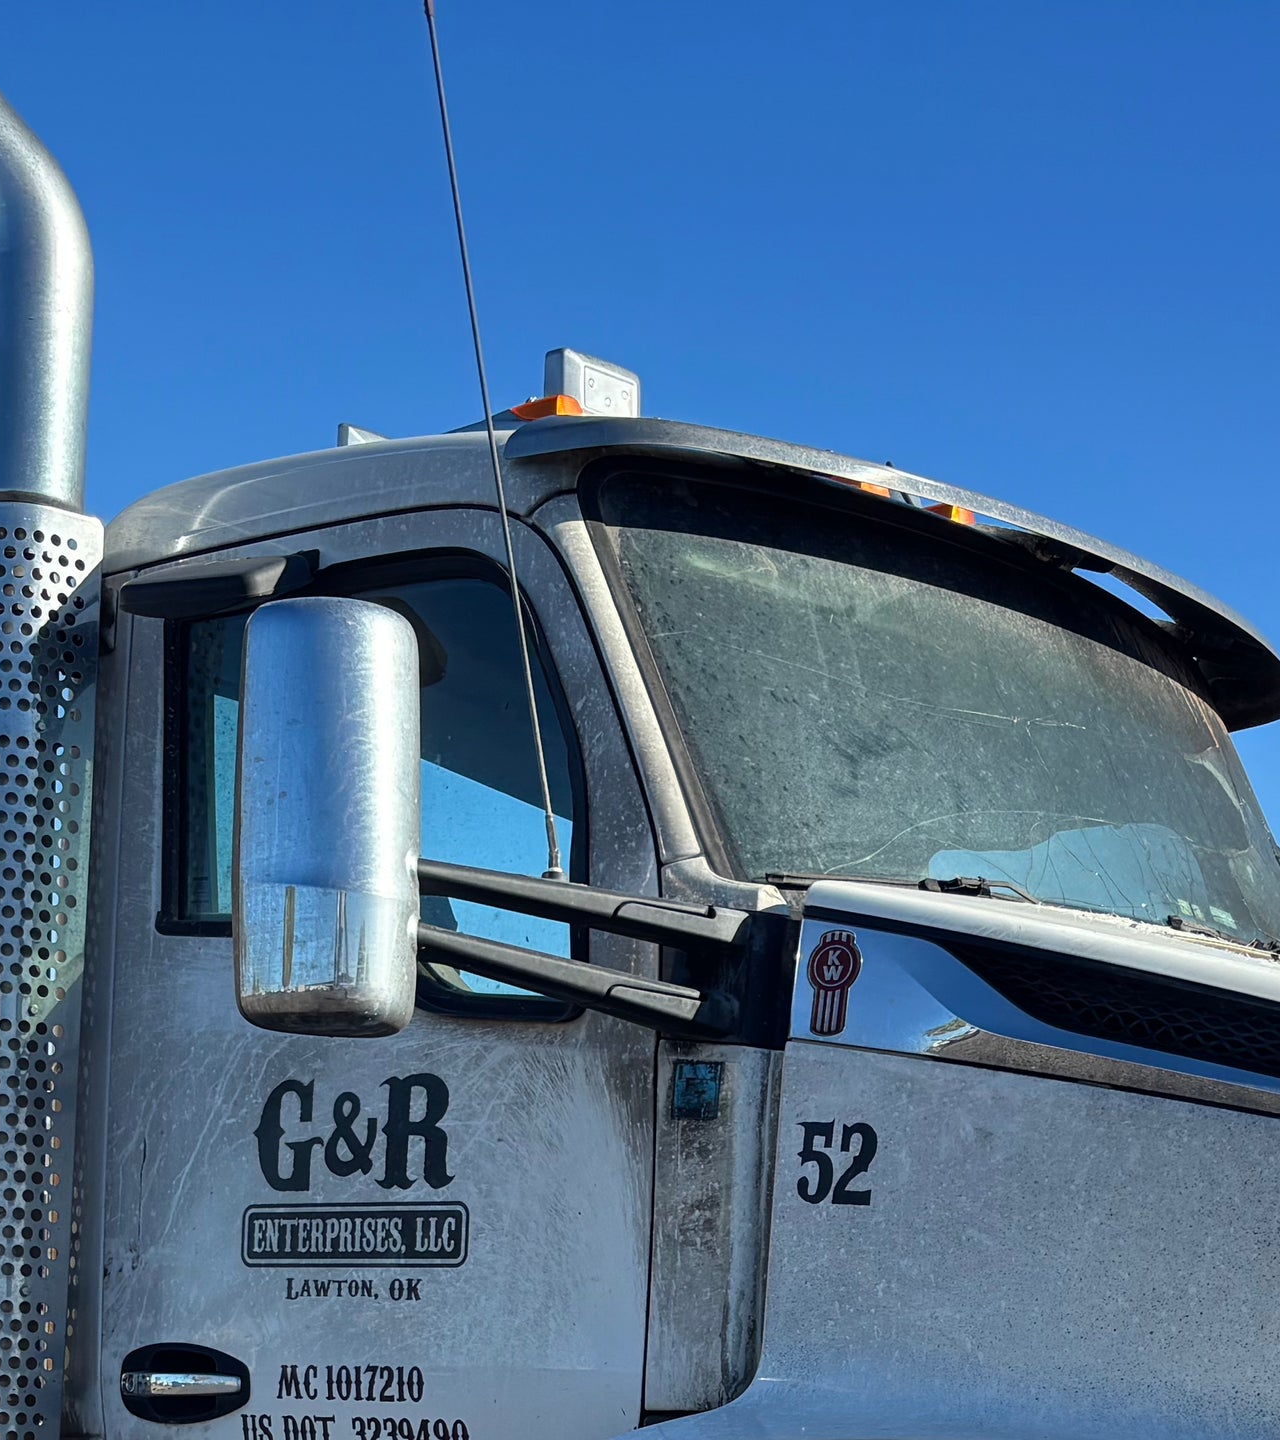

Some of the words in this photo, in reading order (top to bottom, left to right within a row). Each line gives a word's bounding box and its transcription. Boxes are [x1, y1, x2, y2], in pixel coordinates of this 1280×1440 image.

[823, 966, 843, 982] W
[827, 949, 841, 966] K
[253, 1073, 455, 1193] G&R
[796, 1118, 878, 1206] 52
[252, 1216, 407, 1254] ENTERPRISES,
[414, 1216, 456, 1252] LLC
[388, 1278, 423, 1301] OK
[276, 1364, 318, 1400] MC
[325, 1363, 425, 1403] 1017210
